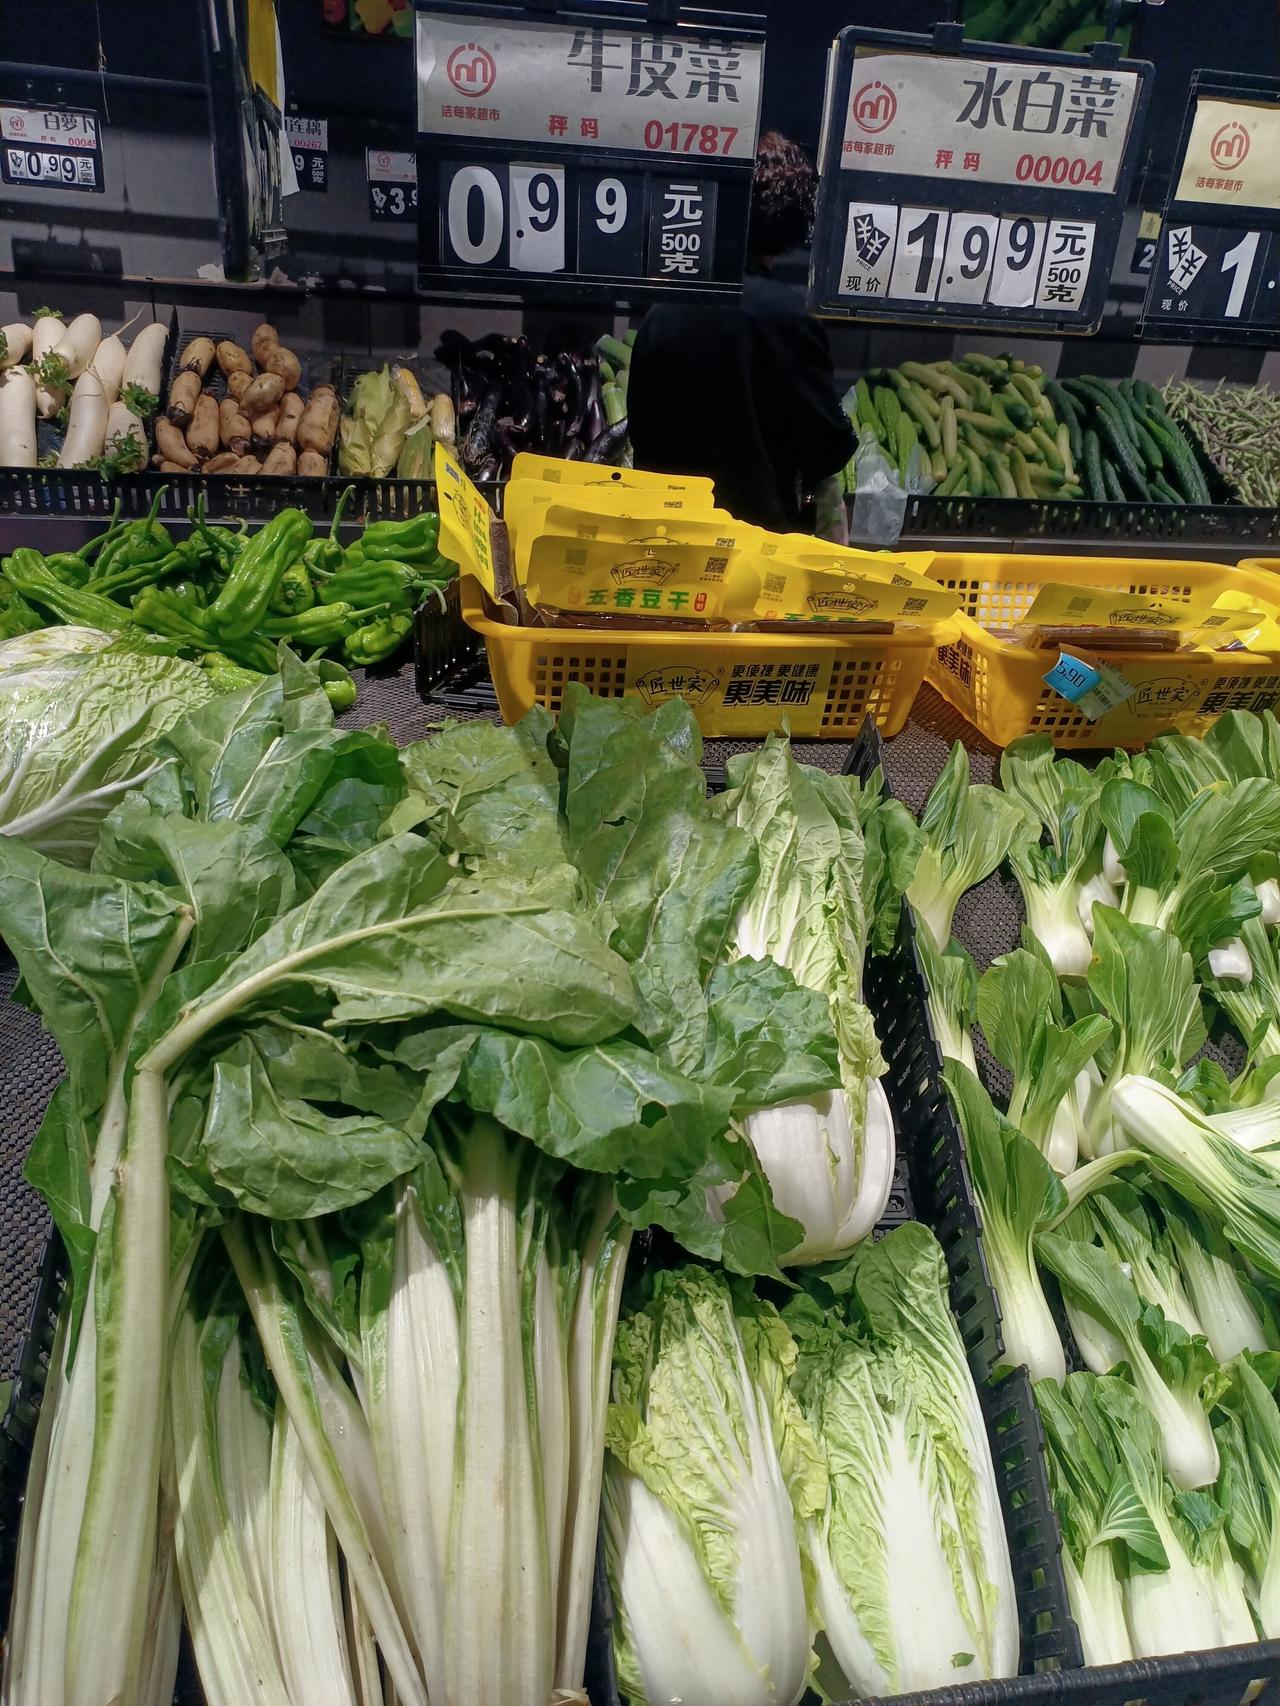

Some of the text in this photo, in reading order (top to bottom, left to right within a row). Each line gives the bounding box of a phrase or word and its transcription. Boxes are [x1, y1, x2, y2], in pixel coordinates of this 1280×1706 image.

[567, 30, 742, 103] 牛皮菜
[441, 104, 501, 121] 洁每家超市
[955, 66, 1122, 138] 水白菜
[43, 112, 96, 134] 白萝卜
[643, 120, 740, 155] 01787
[1015, 154, 1104, 187] 00004
[1195, 176, 1244, 191] 洁每家超市
[448, 165, 628, 265] 0.99
[907, 212, 1036, 294] 1.99
[856, 258, 872, 271] PRICE
[846, 276, 881, 292] 现价
[1166, 280, 1184, 296] PRICE
[586, 587, 690, 611] 五香豆干
[731, 664, 820, 677] 更便捷 更健康
[1055, 660, 1087, 688] 5.90
[650, 675, 706, 695] 匠世家
[721, 679, 816, 706] 更美味
[1251, 676, 1280, 690] 更健
[1137, 686, 1189, 704] 匠世家
